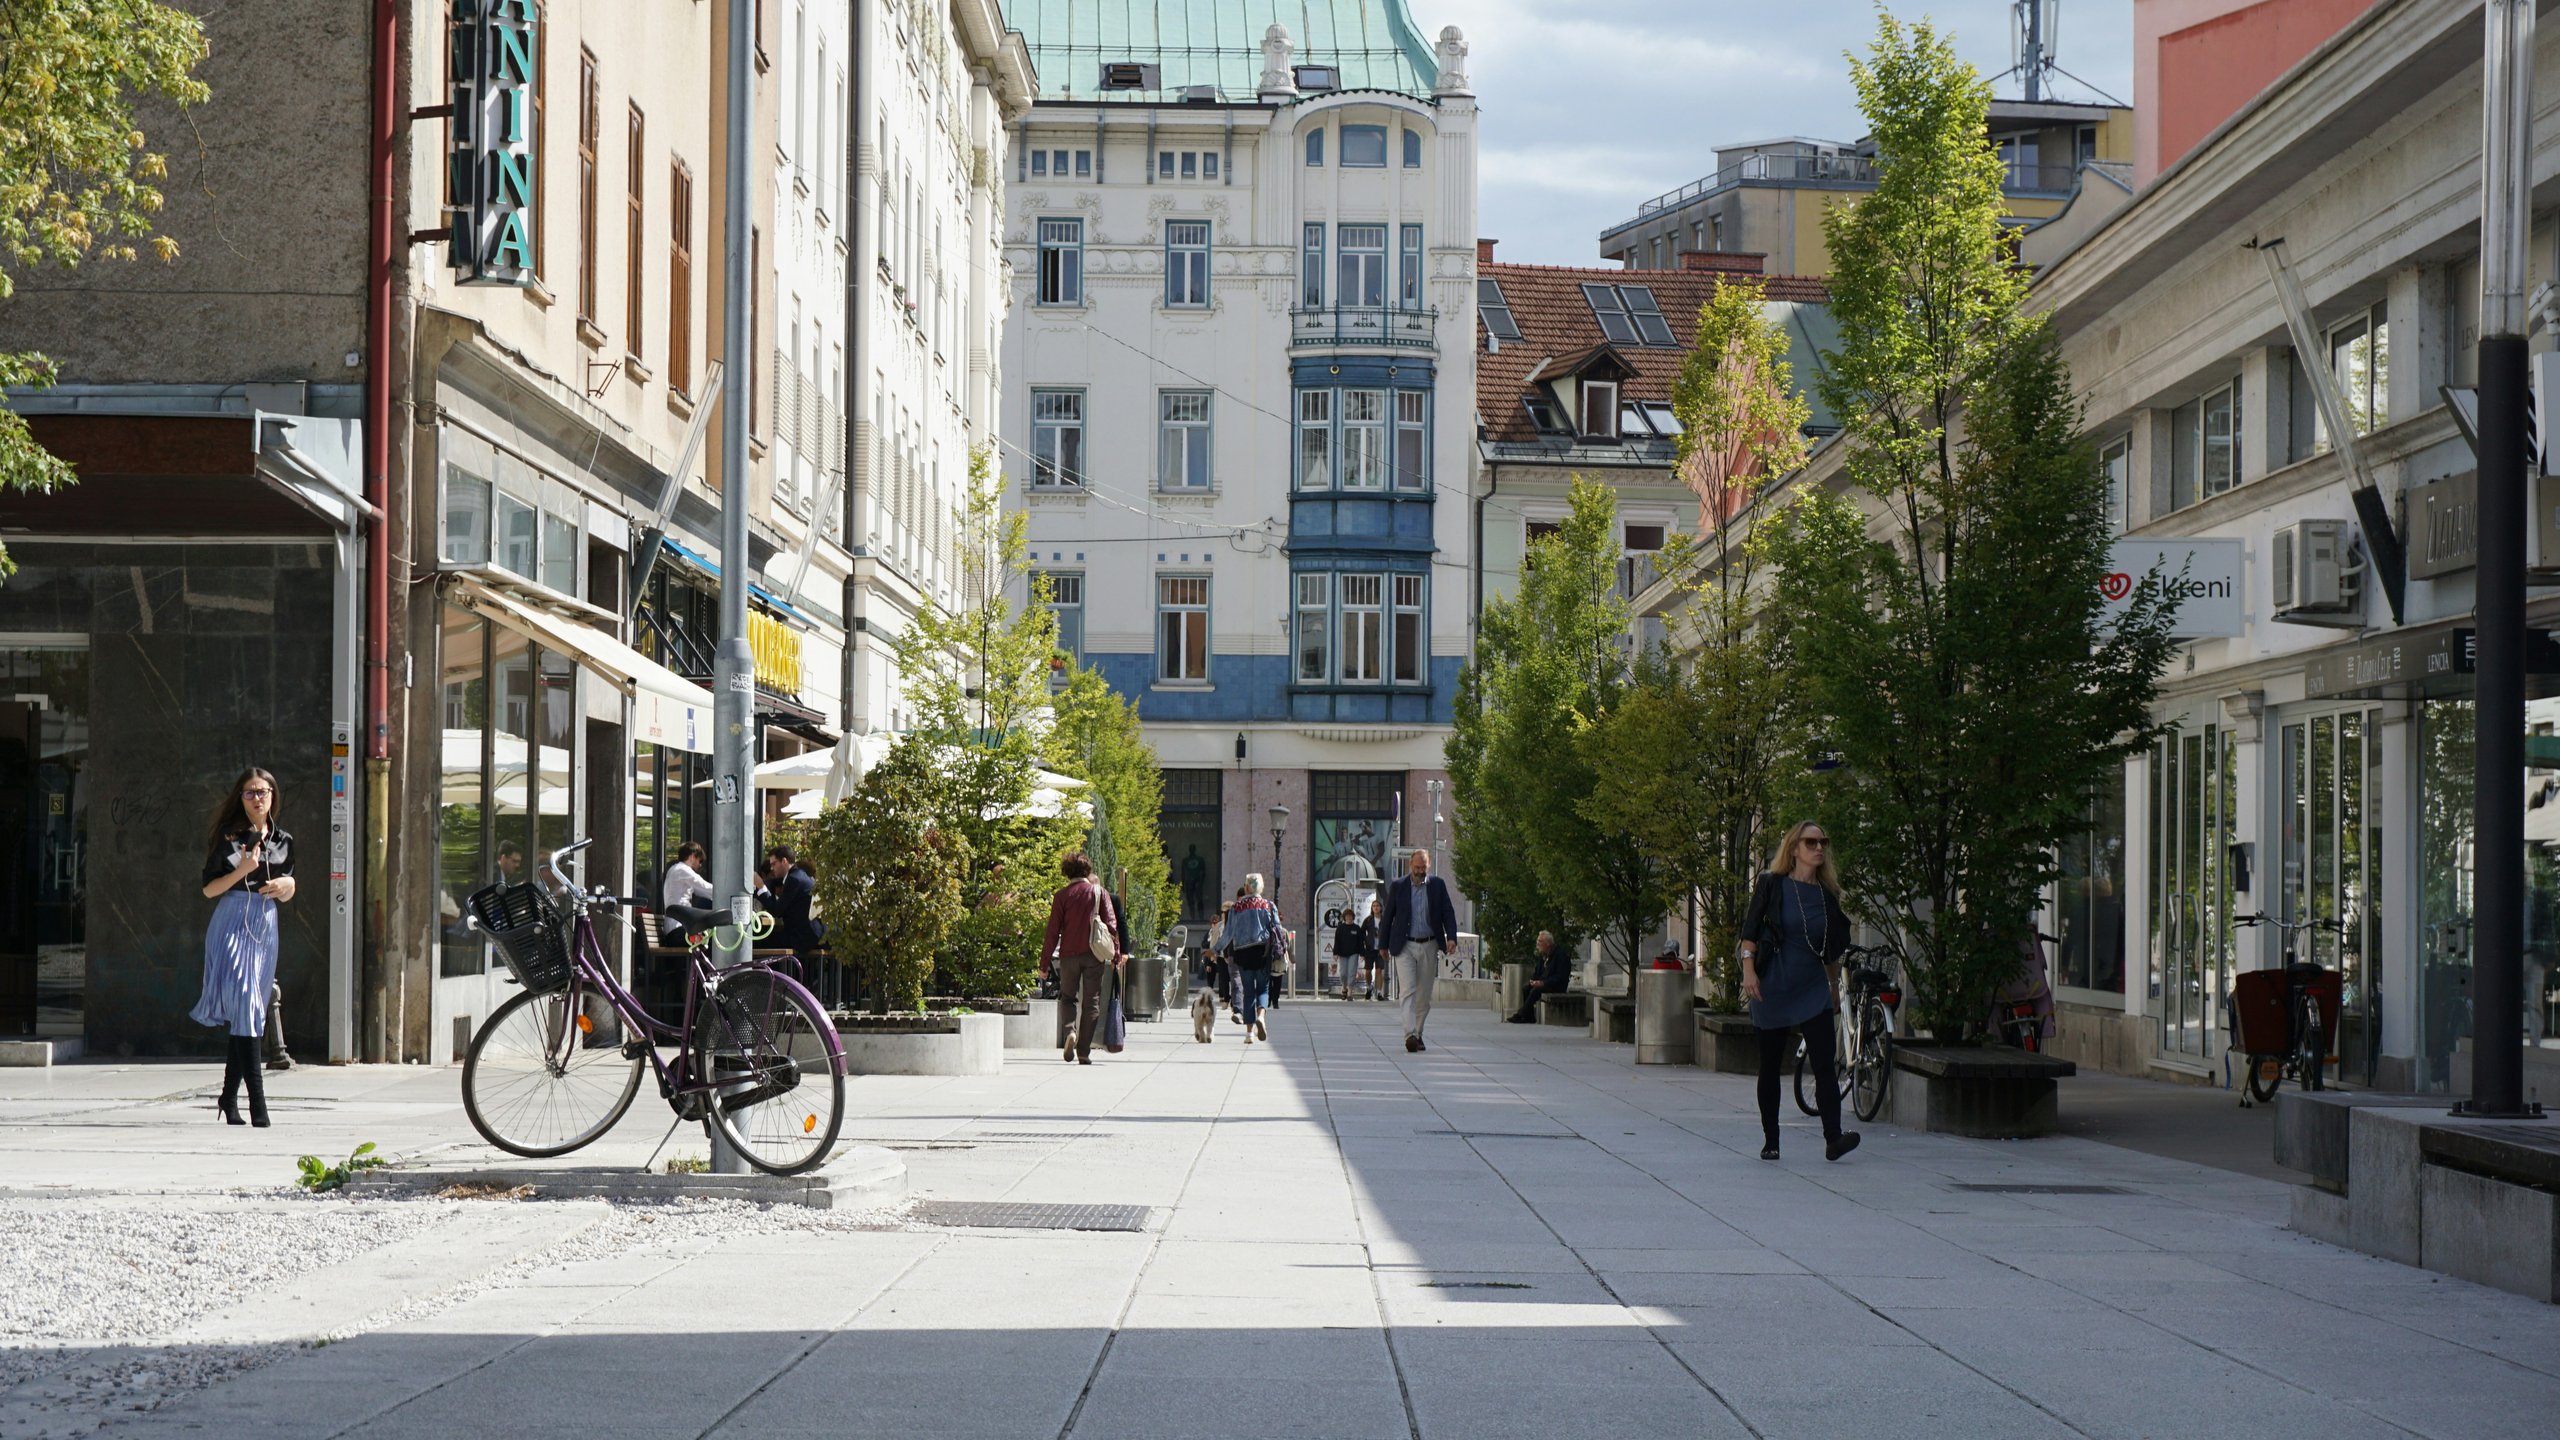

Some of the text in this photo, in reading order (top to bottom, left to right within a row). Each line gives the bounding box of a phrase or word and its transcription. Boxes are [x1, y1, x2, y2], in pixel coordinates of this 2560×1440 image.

[2140, 575, 2231, 598] iskreni
[2428, 652, 2450, 673] LENCIA
[1177, 821, 1214, 829] EXCHANGE
